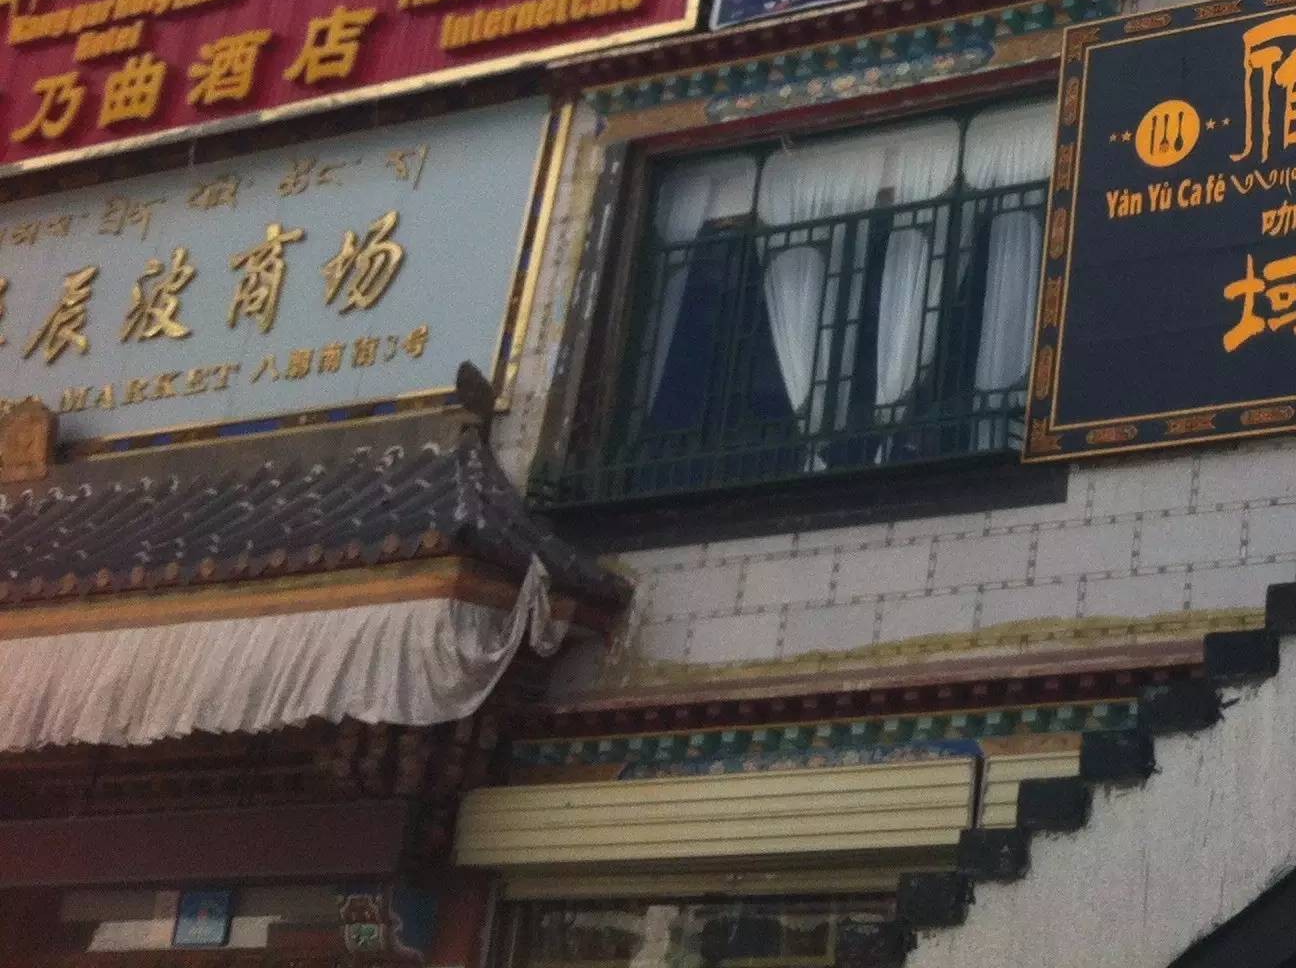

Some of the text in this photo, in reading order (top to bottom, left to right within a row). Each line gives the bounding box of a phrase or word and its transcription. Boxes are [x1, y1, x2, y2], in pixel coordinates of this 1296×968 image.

[10, 6, 377, 142] 乃曲酒店
[0, 209, 405, 365] 辰波商场
[61, 363, 241, 414] MARKET
